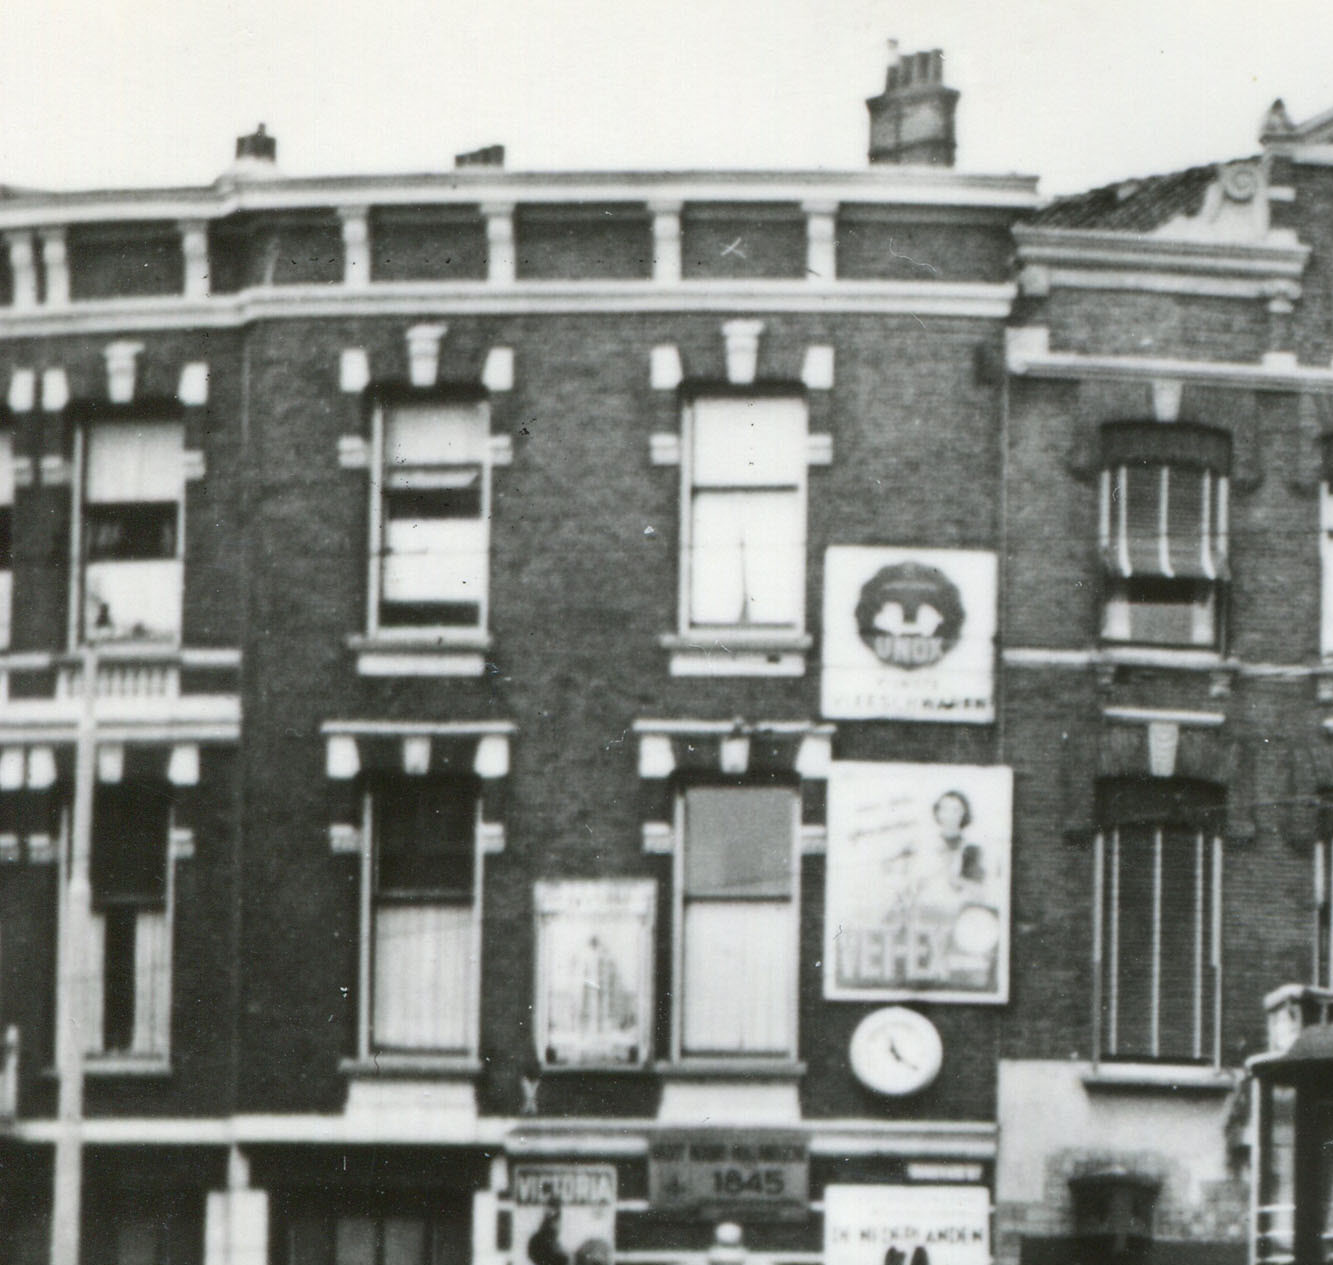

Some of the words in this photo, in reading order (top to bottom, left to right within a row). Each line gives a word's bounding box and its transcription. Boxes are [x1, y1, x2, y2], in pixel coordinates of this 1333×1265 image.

[875, 634, 943, 664] UNOX
[517, 1174, 613, 1204] VICTORIA
[712, 1168, 785, 1194] 1845
